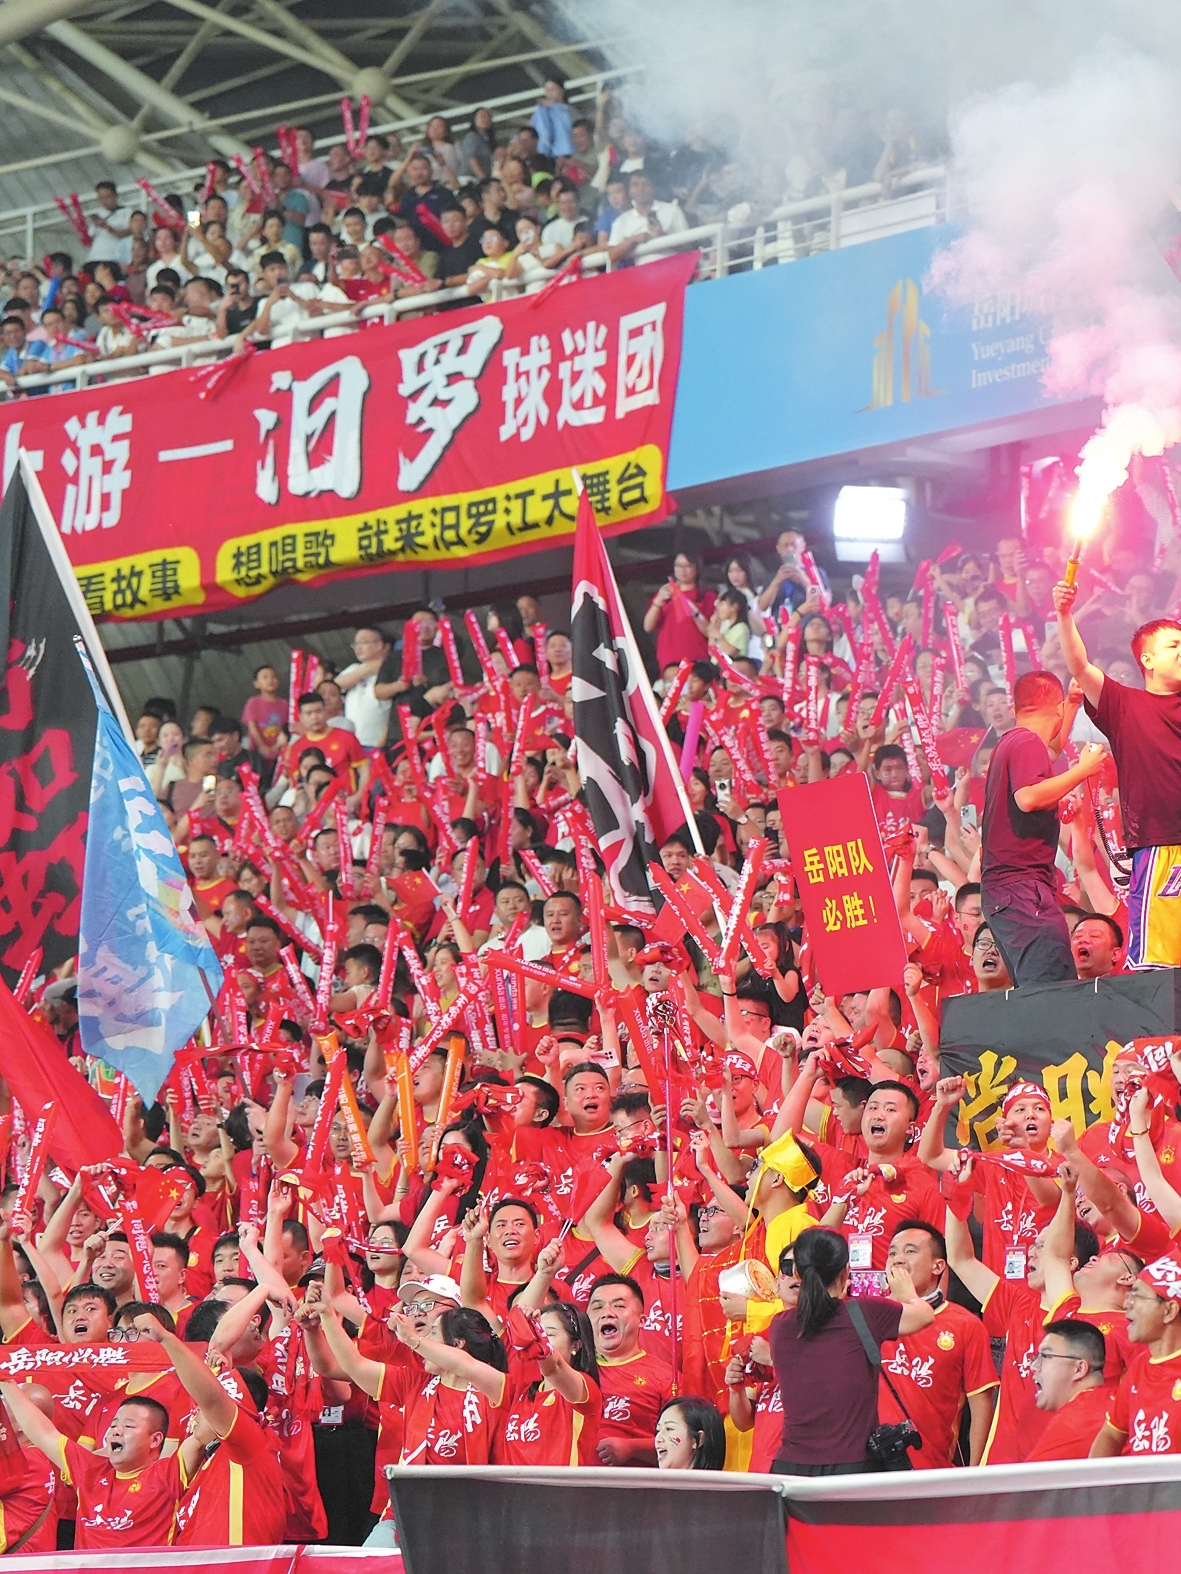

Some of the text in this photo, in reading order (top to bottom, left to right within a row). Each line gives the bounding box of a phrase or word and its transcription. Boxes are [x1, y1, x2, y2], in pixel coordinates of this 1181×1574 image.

[232, 530, 338, 587] 想唱歌
[803, 838, 874, 886] 岳阳队
[494, 968, 504, 995] xunda
[993, 1201, 1040, 1239] 岳陽
[0, 1347, 131, 1375] 岳阳必胜
[881, 1342, 935, 1388] 岳陽
[506, 1412, 541, 1442] 岳陽
[1129, 1409, 1172, 1452] 岳陽
